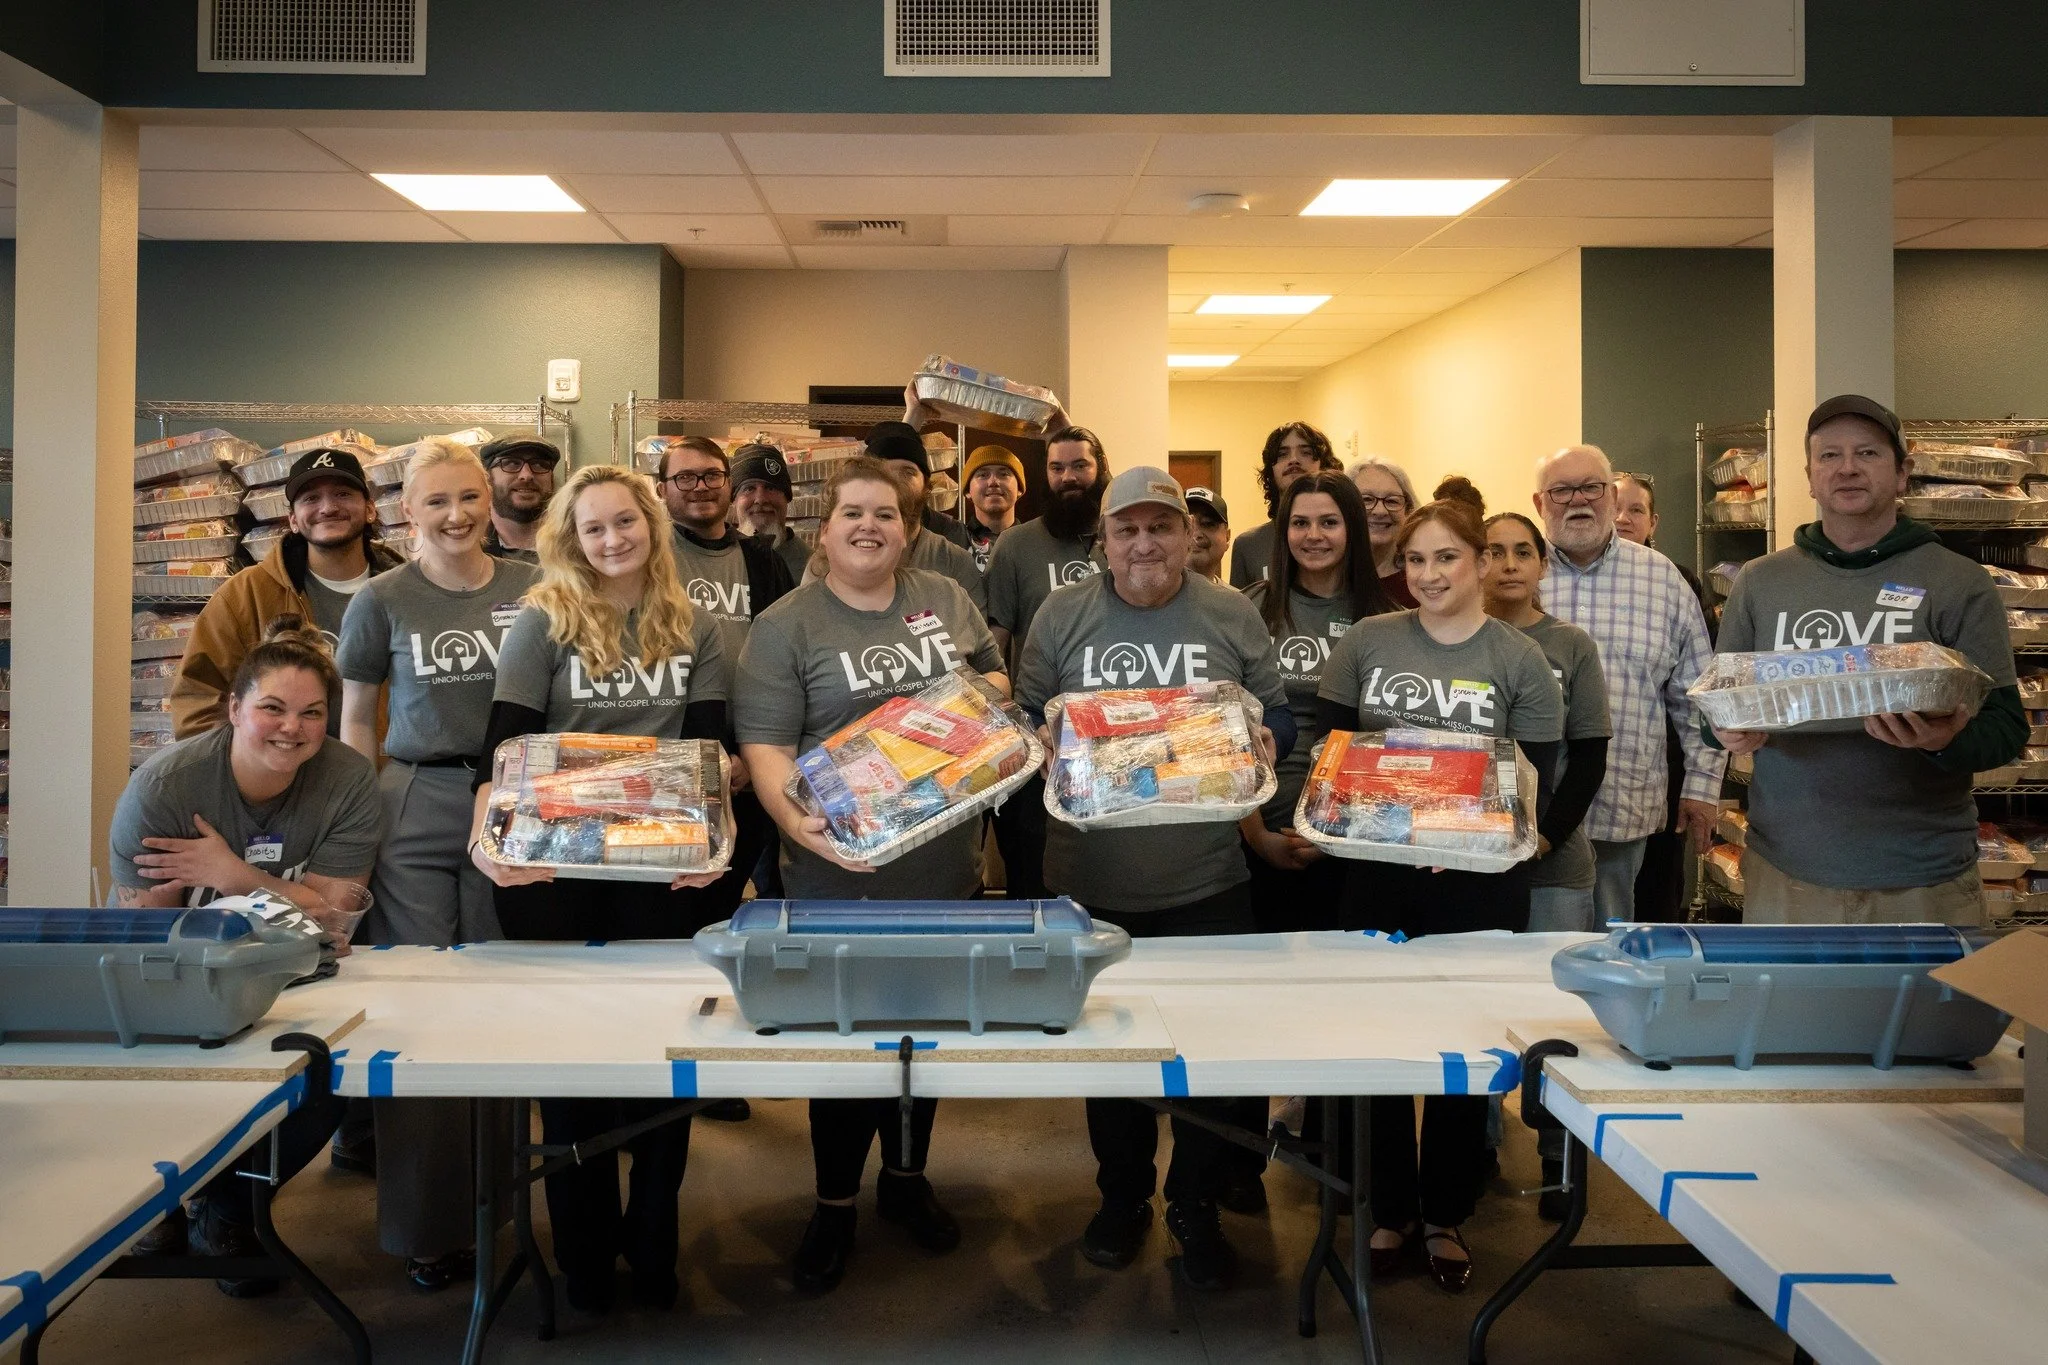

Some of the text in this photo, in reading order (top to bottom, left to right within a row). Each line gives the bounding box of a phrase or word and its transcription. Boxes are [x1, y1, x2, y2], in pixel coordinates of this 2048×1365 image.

[1048, 560, 1101, 592] LO
[686, 578, 751, 615] OVE
[1881, 593, 1909, 603] IGOR
[411, 629, 512, 677] LOV
[839, 631, 962, 692] LOVE
[1083, 642, 1209, 687] LOVE
[432, 672, 494, 685] UNION GOSPEL
[867, 676, 942, 699] UNION GOSPEL MISS
[1279, 672, 1322, 682] NION GOSP
[588, 698, 681, 709] UNION GOSPEL MISSION
[1373, 707, 1480, 735] UNION GOSPEL MISSION
